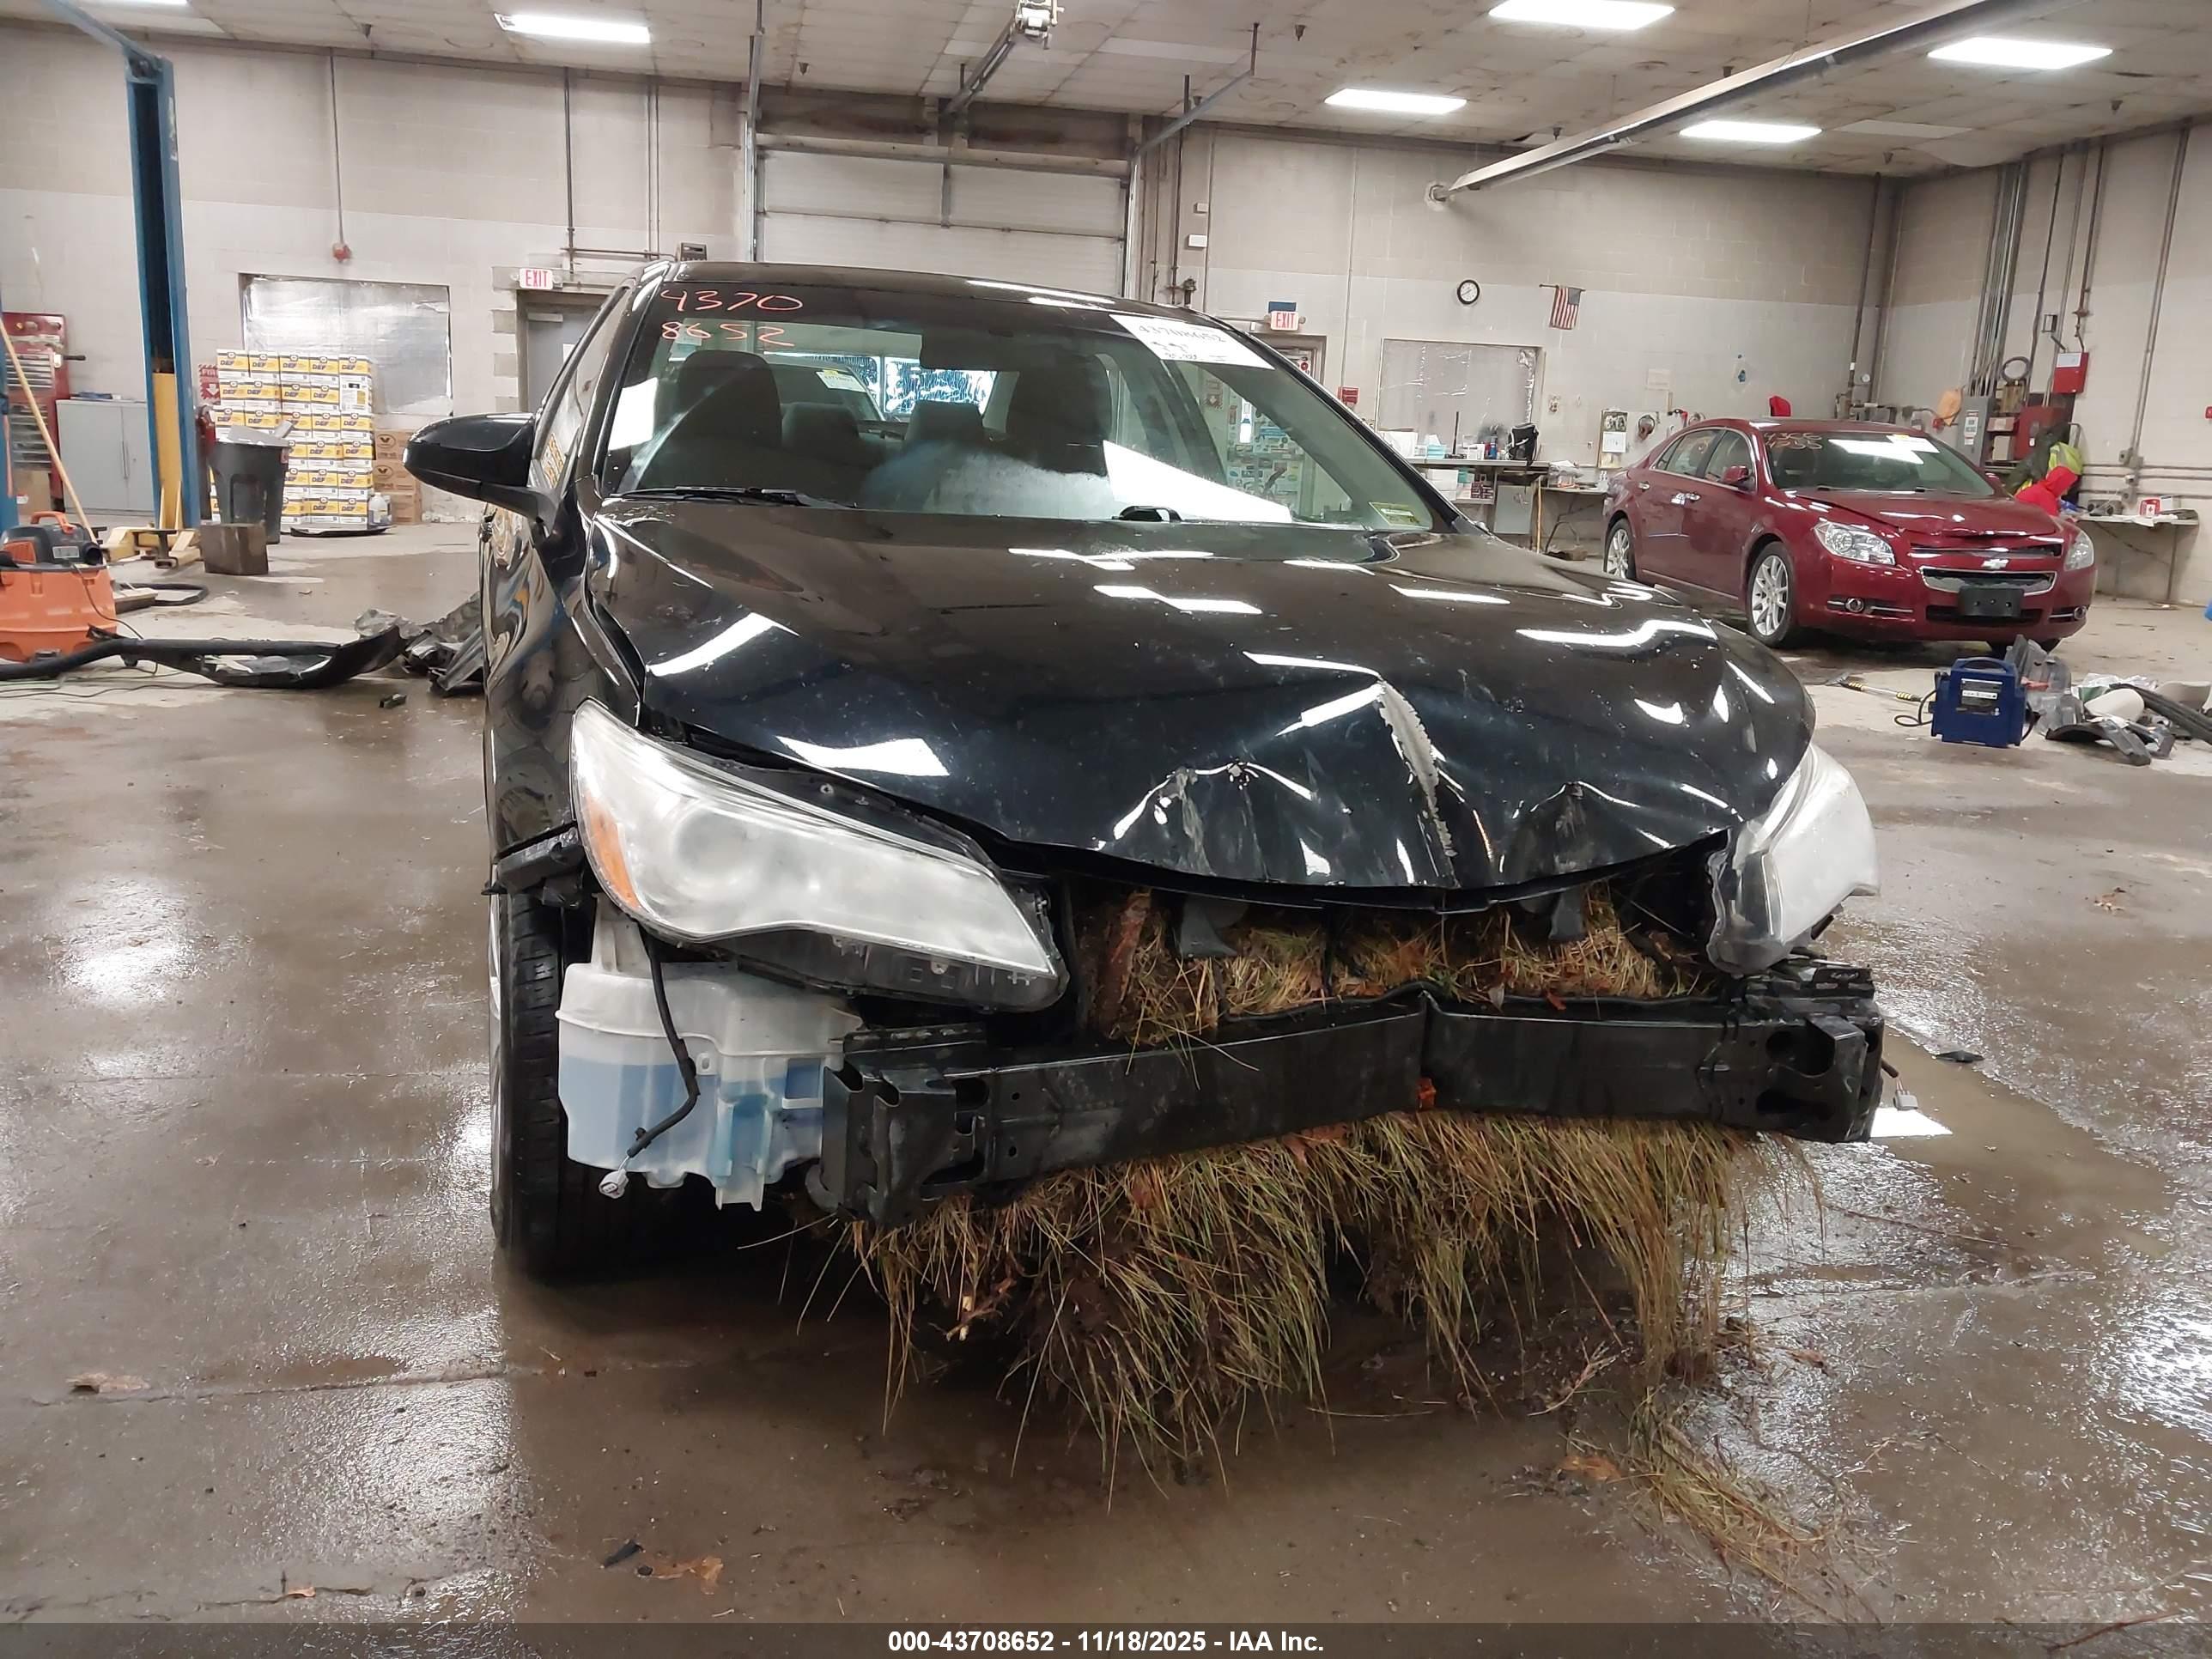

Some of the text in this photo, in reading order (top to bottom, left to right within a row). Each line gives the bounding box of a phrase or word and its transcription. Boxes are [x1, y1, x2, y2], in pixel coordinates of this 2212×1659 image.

[526, 270, 548, 288] EXIT
[659, 289, 804, 312] 4370
[1276, 312, 1296, 329] EXIT
[661, 321, 796, 347] 8652
